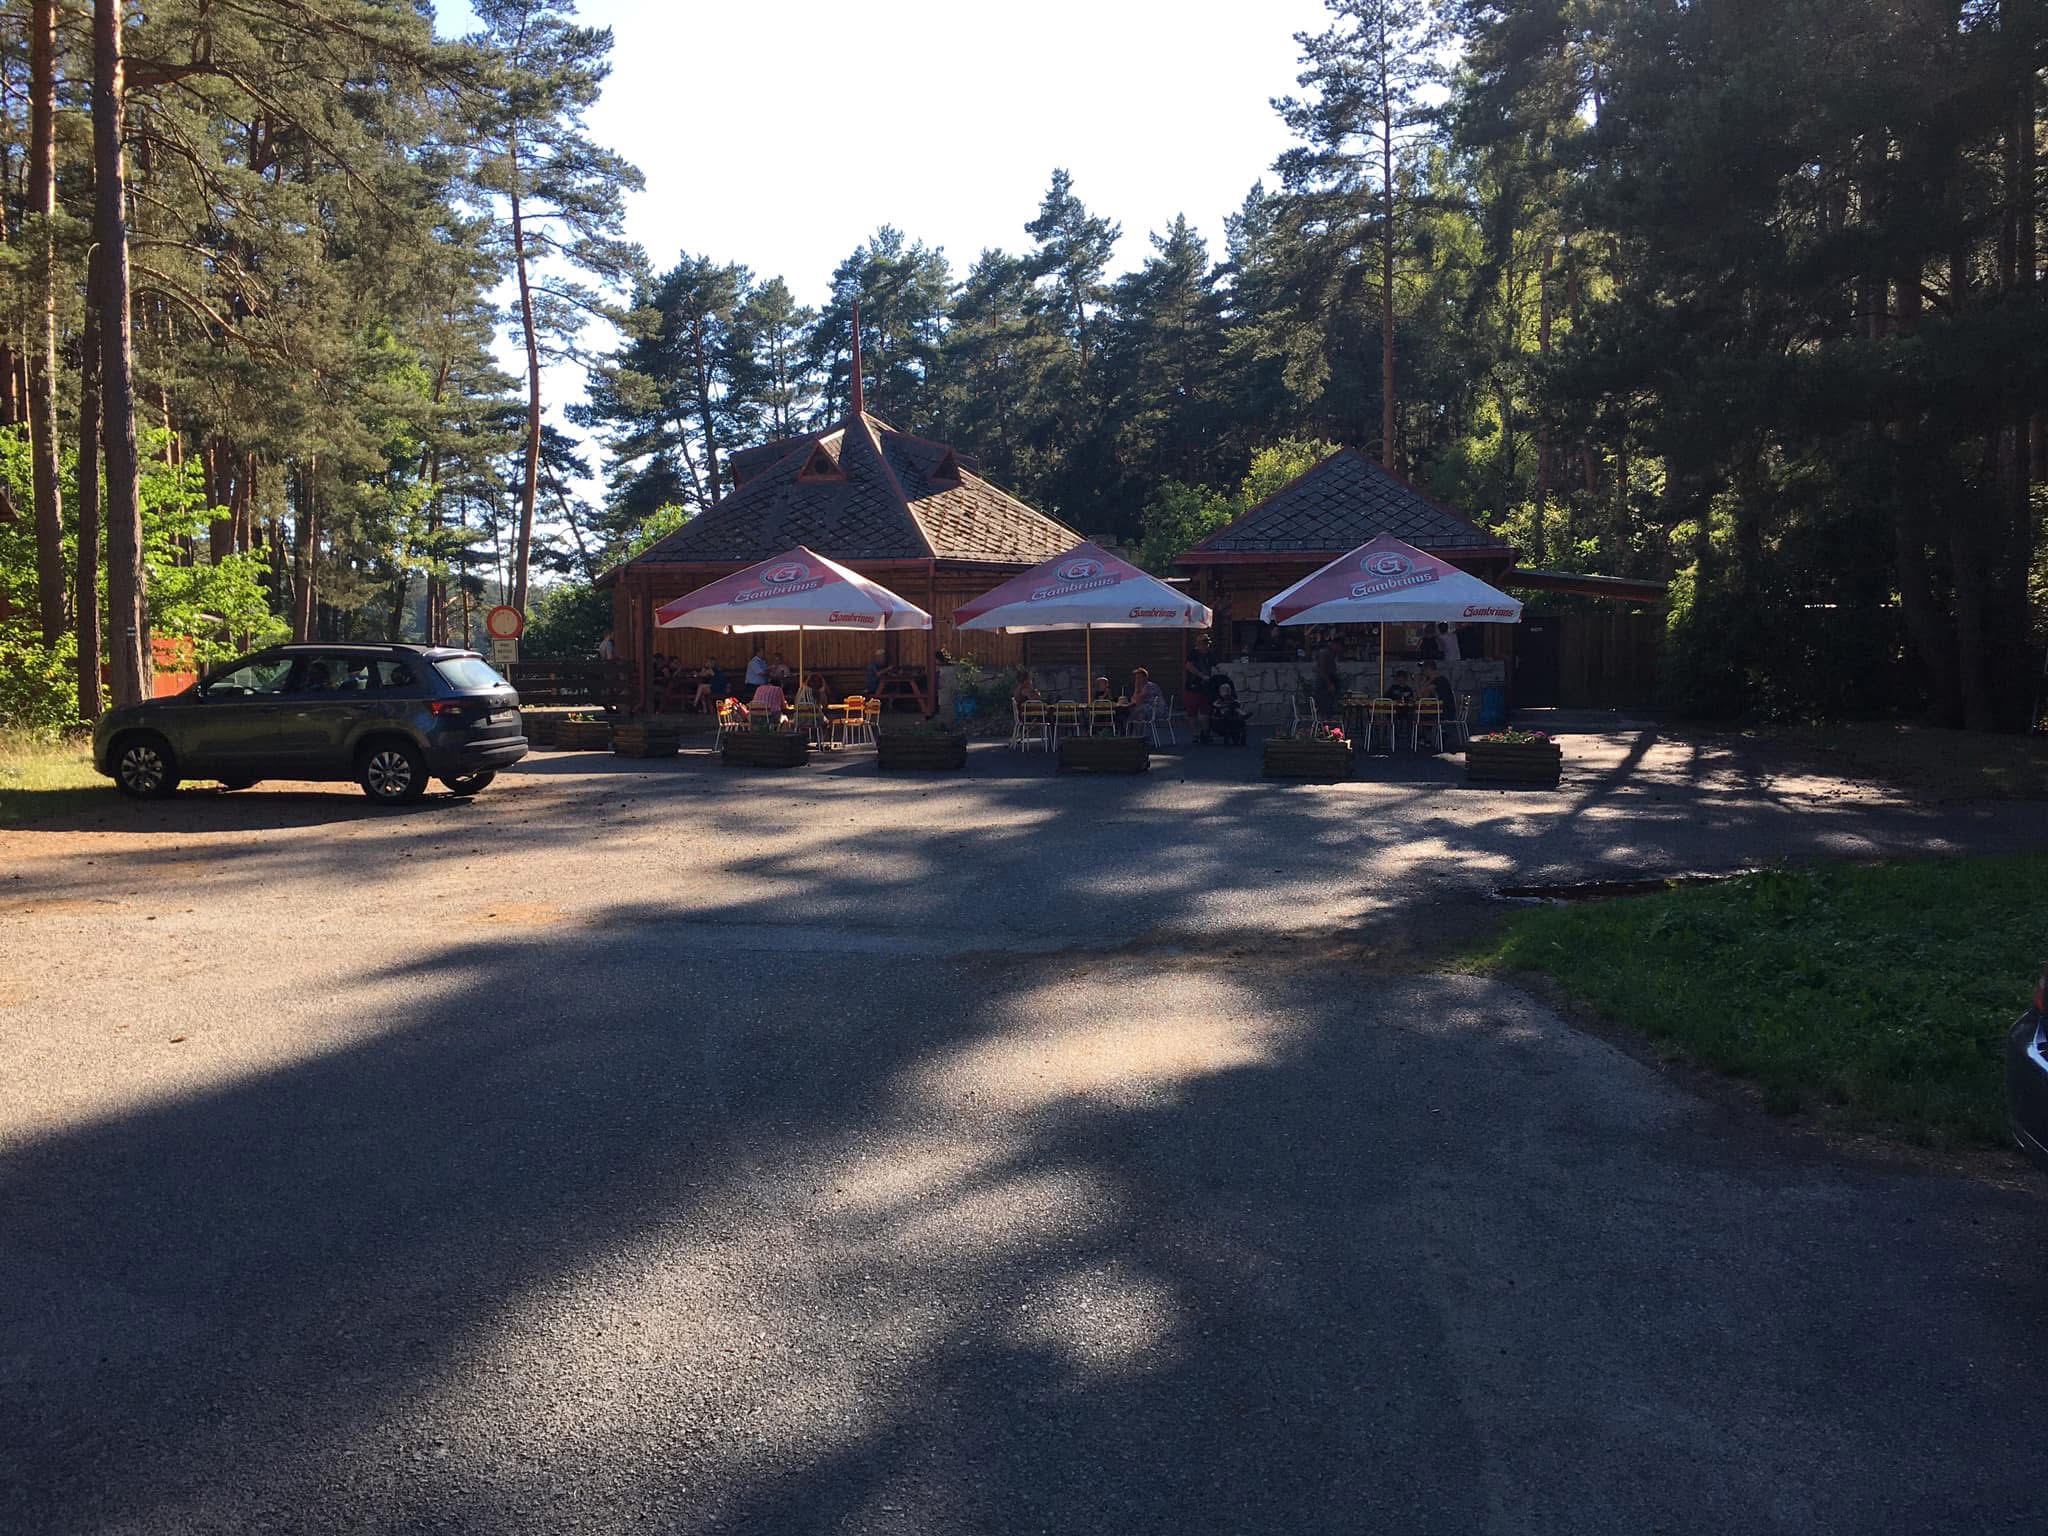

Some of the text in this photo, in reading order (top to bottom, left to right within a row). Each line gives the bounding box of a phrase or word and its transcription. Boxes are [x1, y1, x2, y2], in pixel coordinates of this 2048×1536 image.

[733, 582, 817, 603] Gambrinus
[1031, 578, 1114, 601] Gambrinus
[1351, 573, 1432, 597] Gambrinus
[828, 611, 875, 624] Gambrinus
[1128, 607, 1177, 618] Gambrinus
[1463, 605, 1514, 618] Gambrinus
